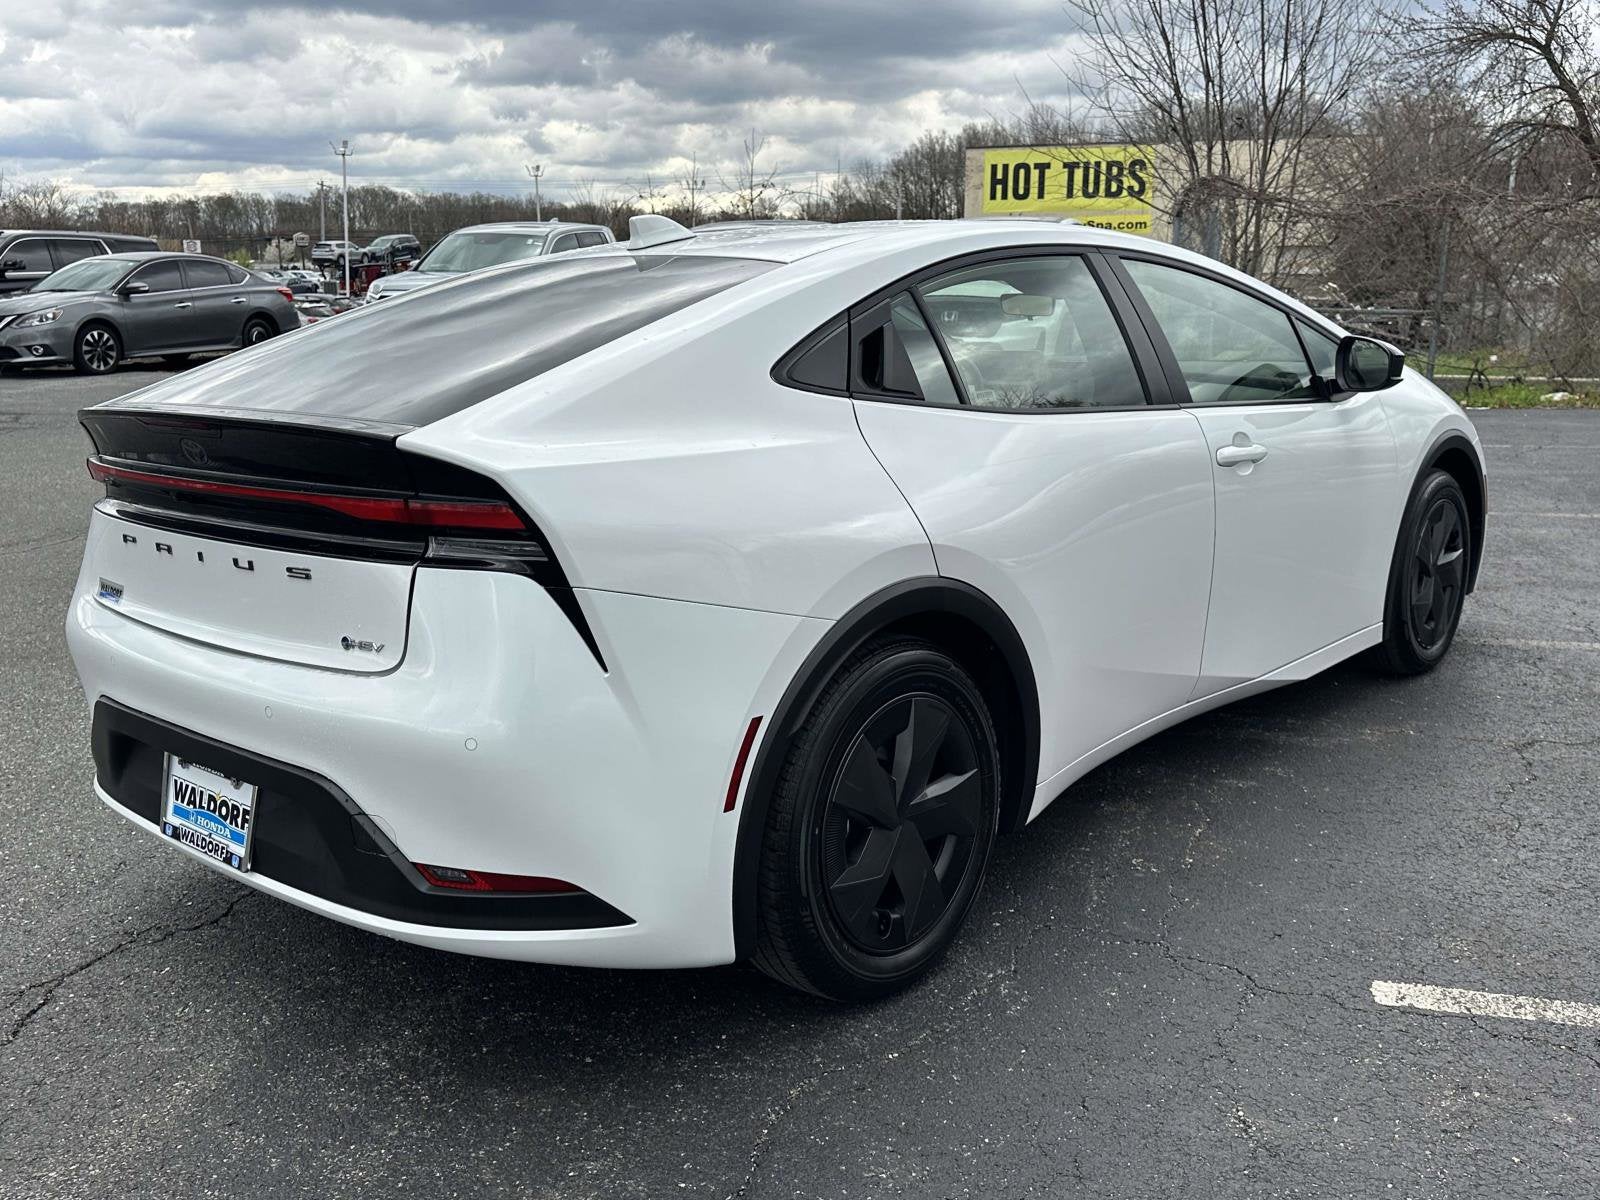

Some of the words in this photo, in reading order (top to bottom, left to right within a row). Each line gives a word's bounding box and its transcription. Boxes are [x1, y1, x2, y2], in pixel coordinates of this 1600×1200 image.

[989, 162, 1051, 201] HOT
[1062, 159, 1148, 199] TUBS
[122, 533, 313, 580] PRIUS
[172, 778, 251, 831] WALDORF
[180, 825, 227, 861] WALDORF
[197, 815, 232, 839] HONDA
